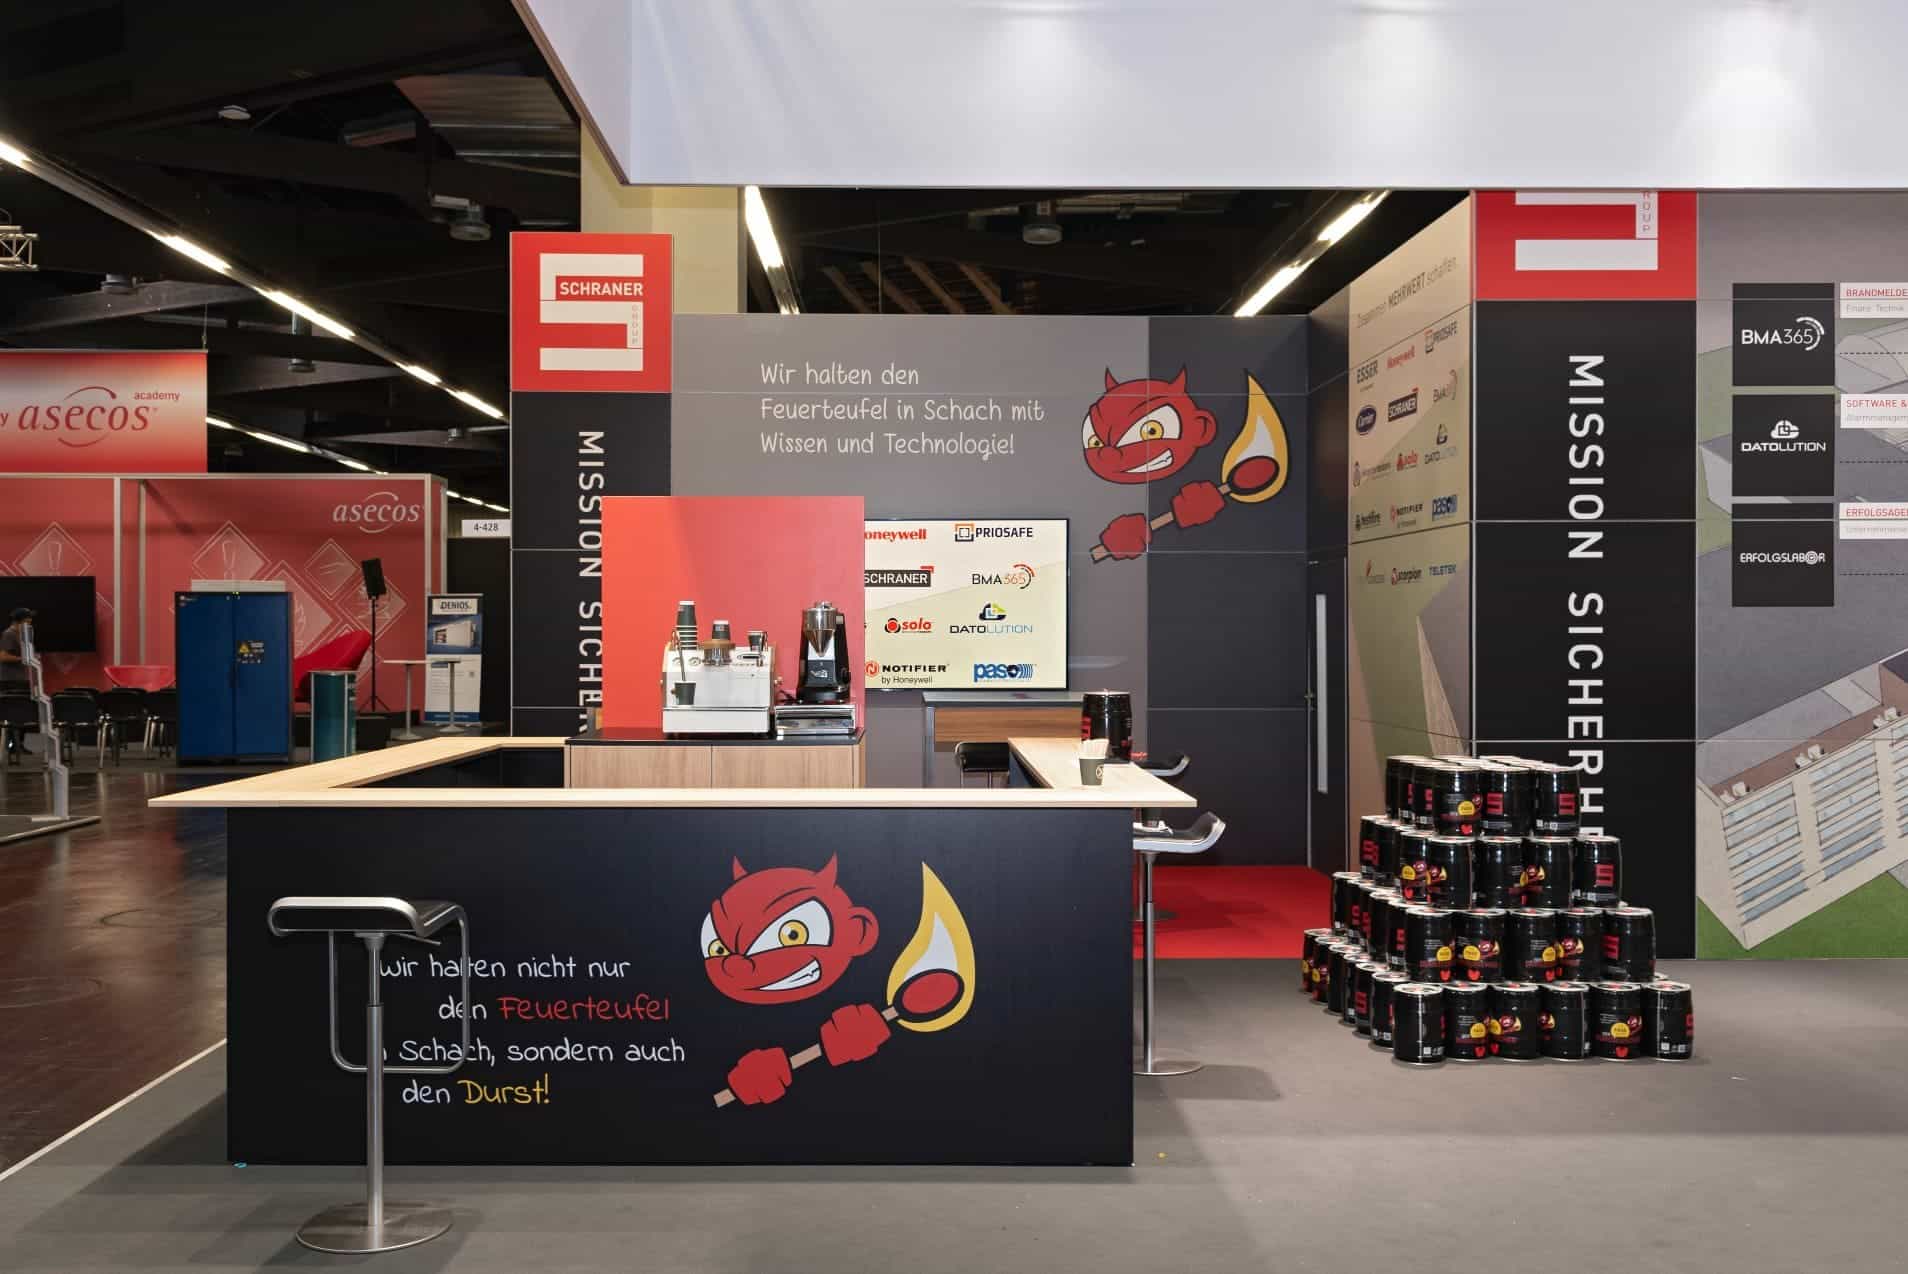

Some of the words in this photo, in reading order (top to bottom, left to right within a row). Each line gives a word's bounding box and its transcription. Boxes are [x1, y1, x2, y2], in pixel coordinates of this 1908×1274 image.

[559, 282, 644, 296] SCHRANER
[1741, 328, 1814, 345] BMA365
[760, 362, 797, 385] Wir
[806, 361, 872, 385] halten
[881, 362, 919, 385] den
[134, 391, 181, 402] academy
[760, 398, 888, 421] Feuerteufel
[897, 400, 915, 421] in
[923, 398, 1002, 421] Schach
[1011, 399, 1046, 421] mit
[18, 404, 151, 432] asecos
[760, 431, 828, 453] Wissen
[837, 432, 874, 453] und
[884, 431, 1015, 461] Technologie!
[1741, 441, 1827, 452] DATOLUTION
[1568, 355, 1605, 559] MISSION
[579, 431, 605, 577] MISSION
[332, 503, 420, 523] asecos
[1846, 508, 1908, 518] ERFOLGSAGE
[473, 522, 499, 533] 4-428
[975, 527, 1033, 538] PRIOSAFE
[864, 573, 928, 584] SCHRANER
[971, 572, 1026, 585] BMA365
[902, 617, 932, 631] solo
[949, 624, 1033, 634] DATOLUTION
[881, 664, 947, 673] NOTIFIER
[881, 676, 891, 684] by
[893, 675, 933, 685] Honeywell
[429, 952, 507, 978] halten
[517, 956, 577, 978] nicht
[588, 960, 632, 978] nur
[438, 994, 488, 1020] den
[496, 993, 671, 1021] Feuerteufel
[399, 1036, 496, 1067] Schach,
[507, 1037, 614, 1063] sondern
[624, 1038, 686, 1063] auch
[402, 1079, 451, 1105] den
[456, 1072, 552, 1105] Durst!
